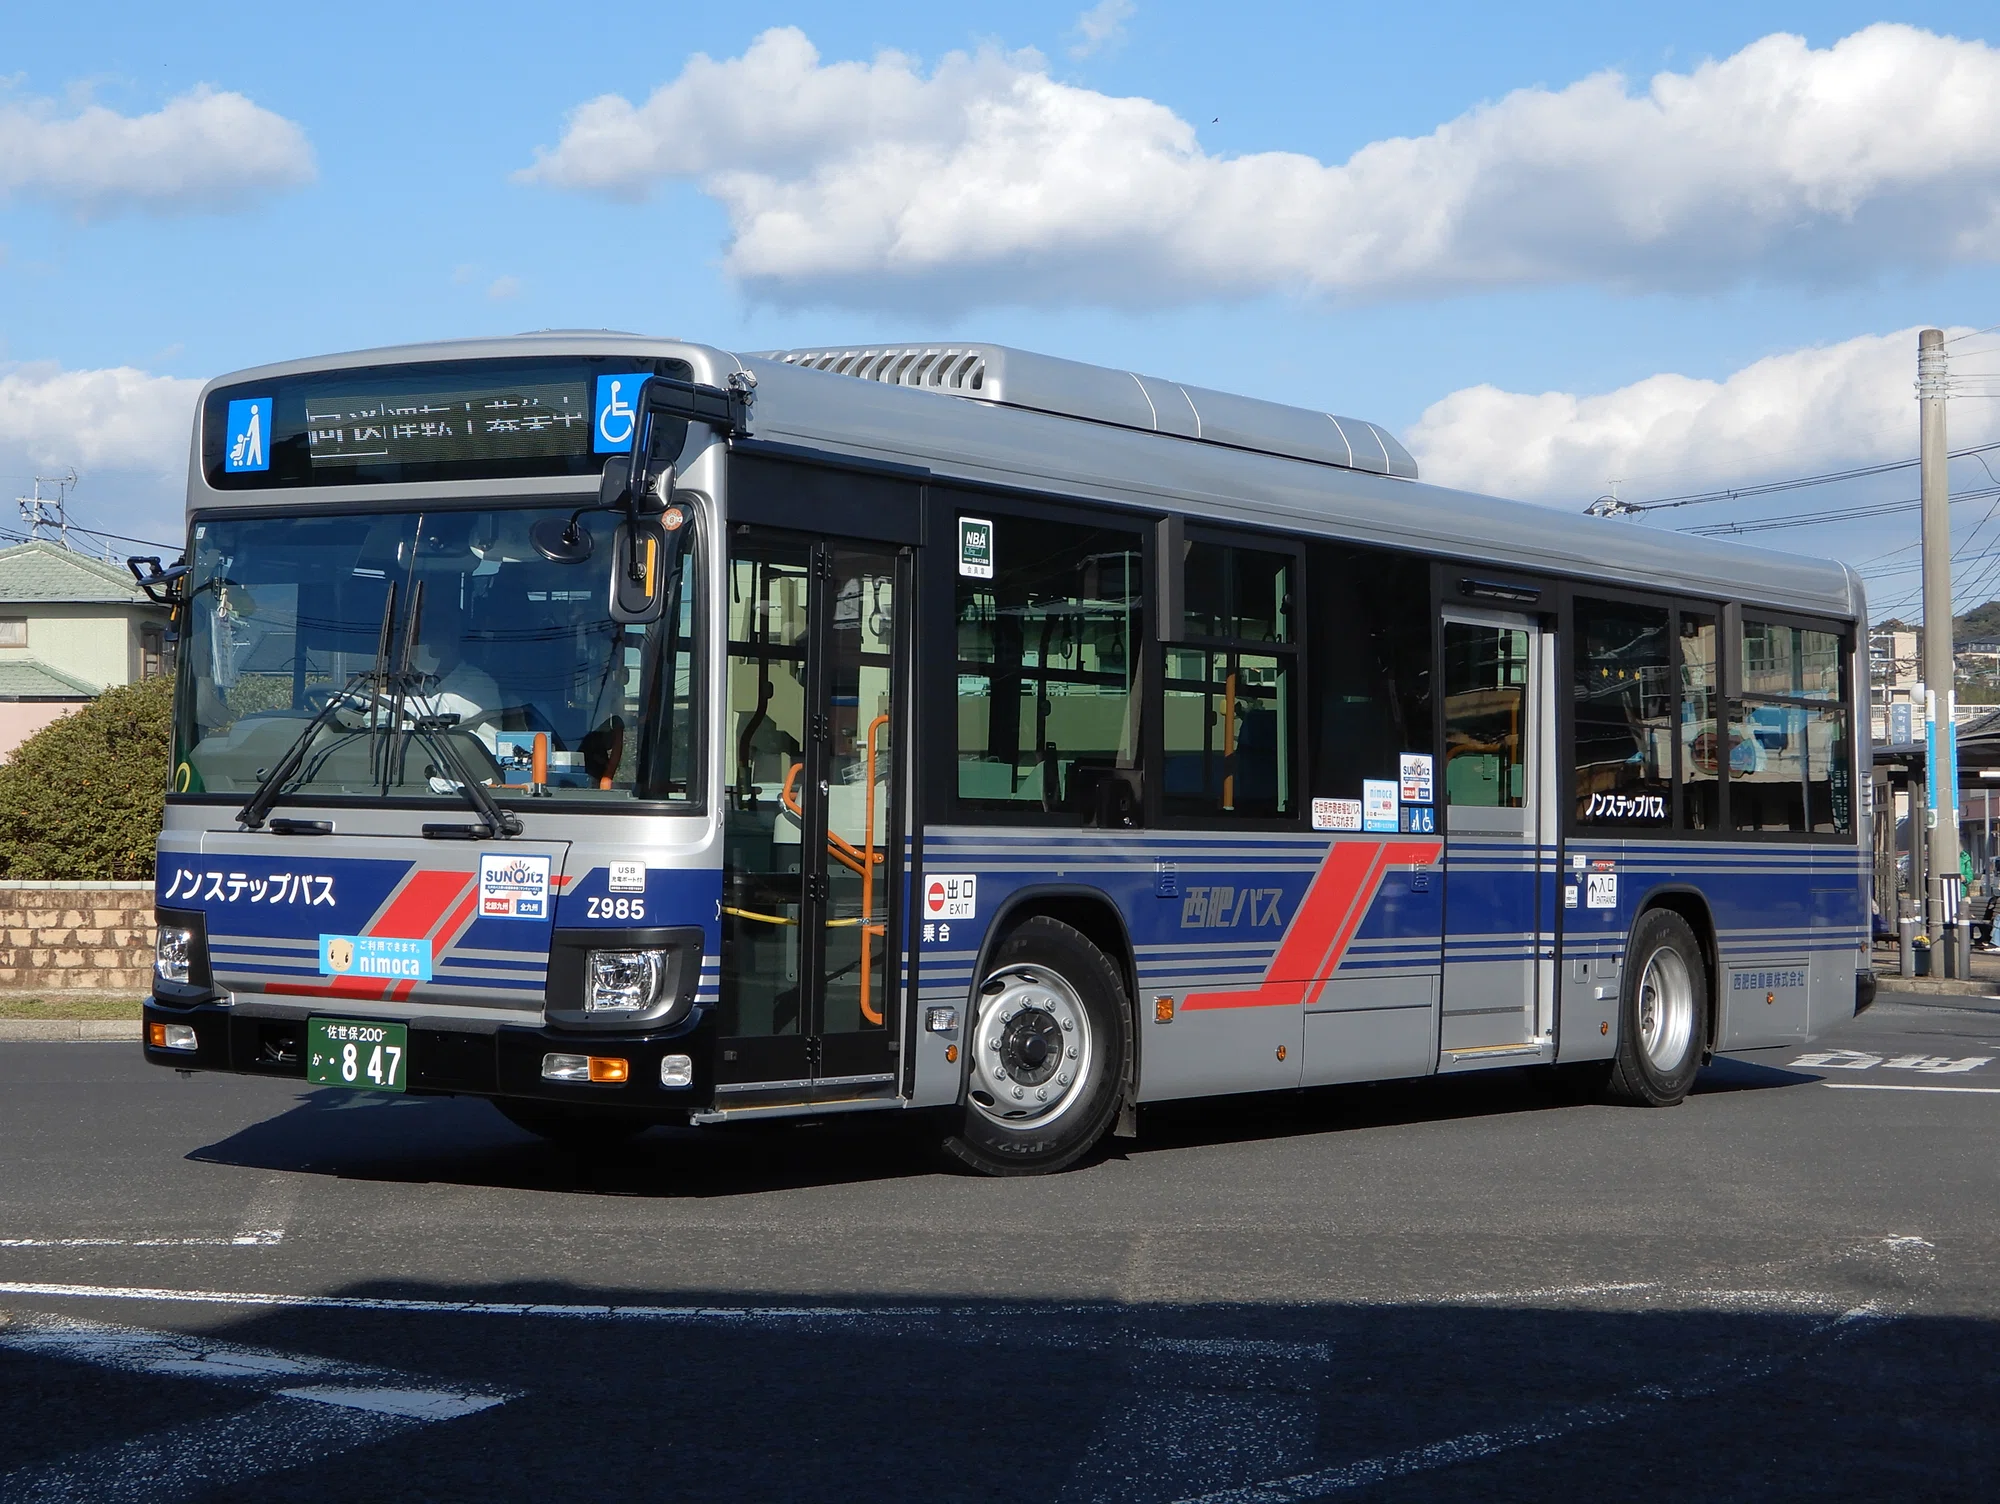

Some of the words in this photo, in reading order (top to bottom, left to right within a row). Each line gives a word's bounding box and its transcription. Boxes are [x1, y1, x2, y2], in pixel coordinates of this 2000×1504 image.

[966, 531, 986, 546] NBA
[1370, 786, 1392, 798] nimoca
[1585, 793, 1665, 818] ノンステップバス
[165, 869, 336, 907] ノンステップバス
[947, 879, 973, 899] 出口
[1599, 877, 1614, 892] 入口
[485, 901, 508, 911] 北部九州
[520, 902, 538, 912] 全九州
[587, 897, 645, 920] Z985
[950, 904, 969, 914] EXIT
[1180, 887, 1283, 928] 西肥バス
[923, 923, 950, 943] 乗合
[359, 940, 420, 954] ご利用できます。
[360, 952, 420, 976] nimoca
[1733, 970, 1804, 990] 西肥自動車株式会社
